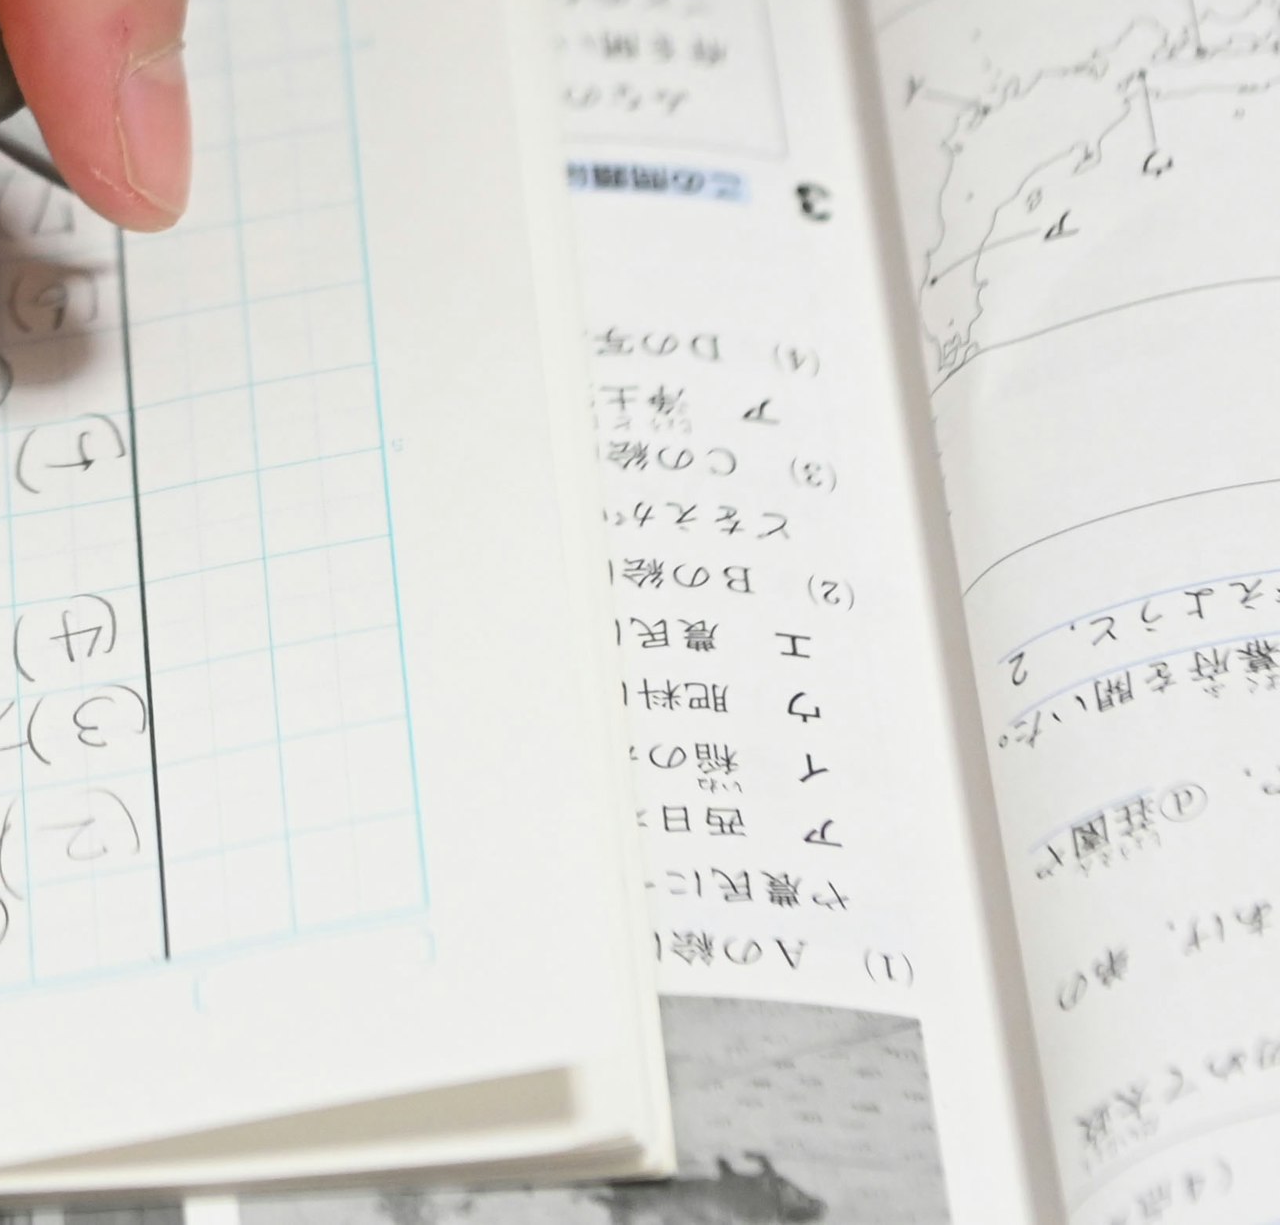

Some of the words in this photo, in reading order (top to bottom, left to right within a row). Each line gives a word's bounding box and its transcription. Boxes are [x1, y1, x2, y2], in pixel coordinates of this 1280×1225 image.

[584, 326, 723, 364] Dの写
[740, 397, 781, 427] ア
[15, 412, 127, 495] (5)
[594, 440, 738, 478] Cの絵
[790, 456, 838, 495] (3)
[807, 574, 855, 613] (2)
[13, 594, 117, 683] (4)
[774, 631, 812, 660] エ
[26, 684, 147, 766] (3)
[786, 691, 822, 724] ウ
[696, 776, 744, 795] いね
[798, 752, 829, 784] イ
[802, 818, 844, 849] ア
[642, 866, 850, 913] や農民に
[864, 948, 914, 989] (1)
